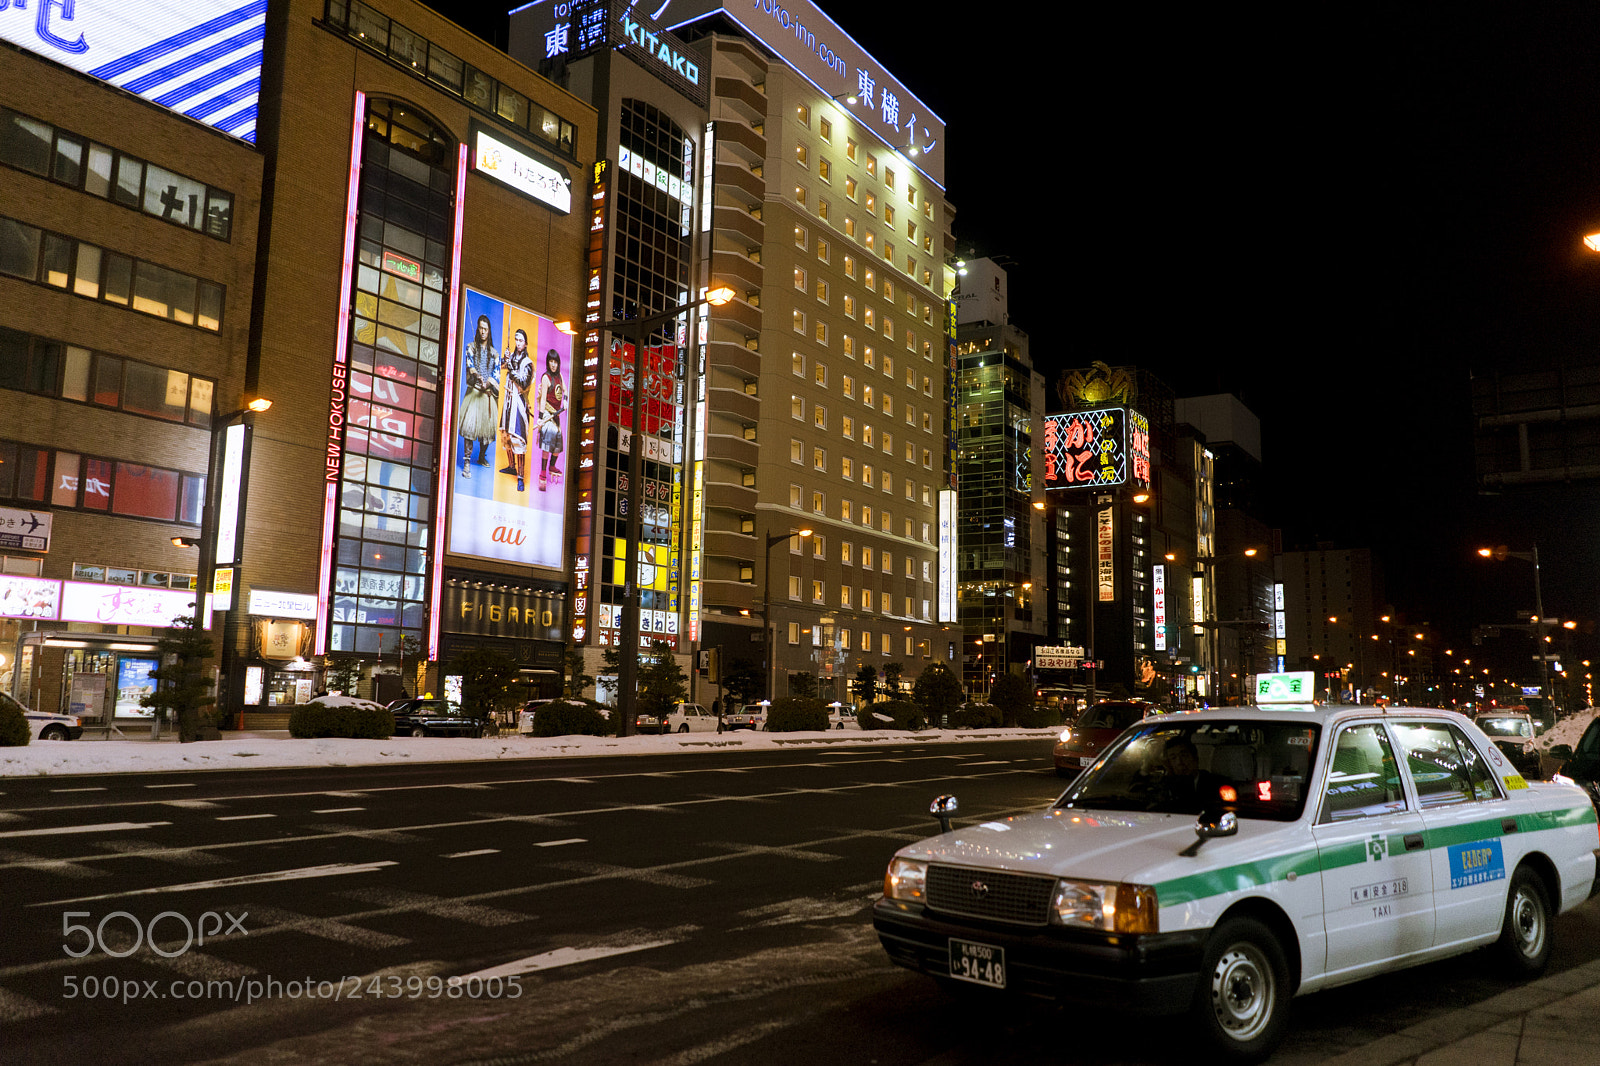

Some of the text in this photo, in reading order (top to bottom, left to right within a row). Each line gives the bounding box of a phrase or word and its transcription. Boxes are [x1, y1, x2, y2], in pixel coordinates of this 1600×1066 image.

[624, 15, 699, 86] KITAKO
[856, 67, 937, 154] 東横イン
[326, 363, 347, 481] NEW HOKUSEI
[491, 525, 527, 546] au
[461, 601, 553, 627] FIGARO
[1372, 904, 1391, 918] TAXI
[961, 957, 1003, 984] 94-48
